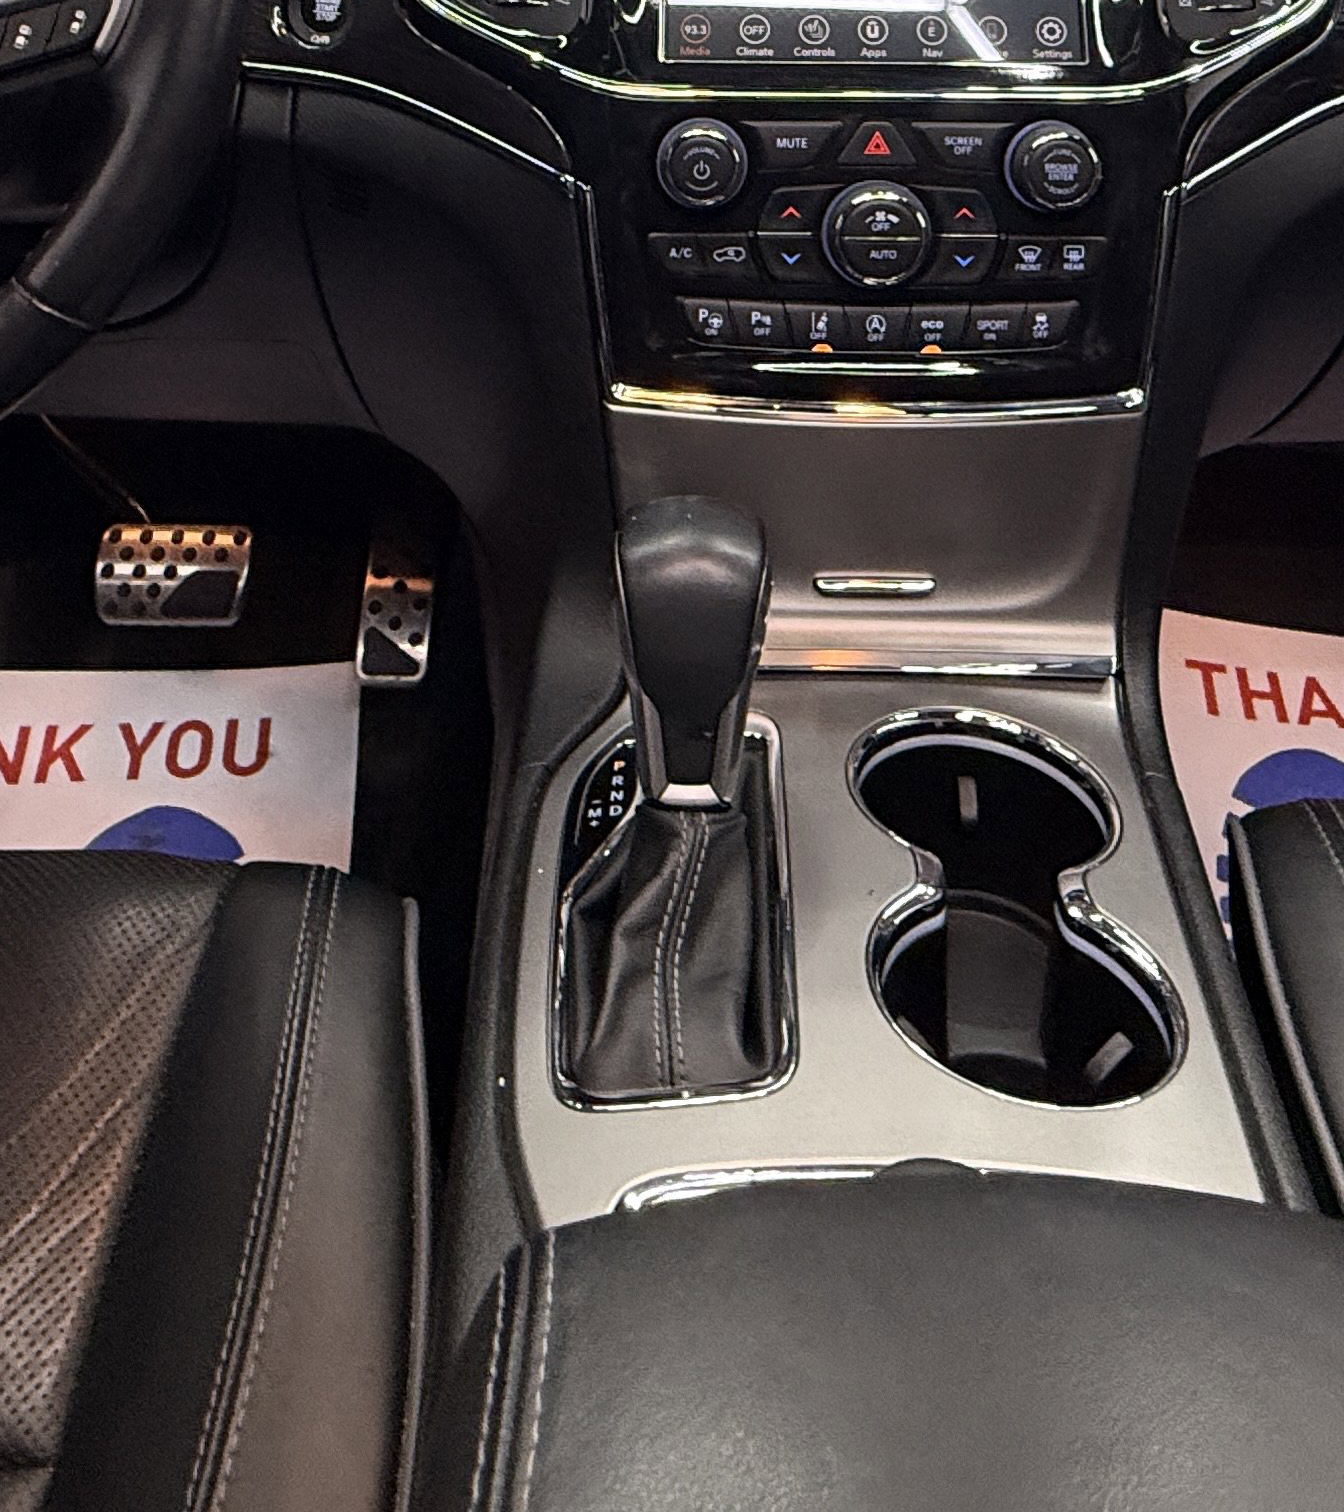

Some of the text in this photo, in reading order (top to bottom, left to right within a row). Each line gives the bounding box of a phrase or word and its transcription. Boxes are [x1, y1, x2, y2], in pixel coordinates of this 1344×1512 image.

[684, 24, 707, 35] 93.3
[743, 24, 765, 36] OFF
[680, 47, 710, 56] Media
[736, 46, 774, 56] Climate
[793, 46, 836, 56] Controls
[860, 47, 887, 58] Apps
[922, 48, 943, 58] Nav
[1032, 49, 1073, 59] Settings
[776, 138, 808, 149] MUTE
[944, 136, 983, 146] SCREEN
[953, 146, 973, 156] OFF
[1044, 163, 1078, 173] BROWSE
[871, 222, 891, 232] OFF
[669, 248, 693, 259] A/C
[870, 250, 897, 260] AUTO
[1015, 263, 1042, 272] FRONT
[1063, 262, 1085, 271] REAR
[698, 308, 709, 323] P
[751, 311, 761, 325] P
[871, 318, 881, 329] A
[920, 320, 944, 330] eco
[976, 320, 1009, 331] SPORT
[704, 327, 718, 336] ON
[753, 327, 772, 336] OFF
[810, 331, 827, 340] OFF
[867, 333, 885, 342] OFF
[924, 333, 943, 342] OFF
[118, 716, 274, 781] YOU
[608, 759, 626, 817] P R N D
[587, 807, 603, 818] M
